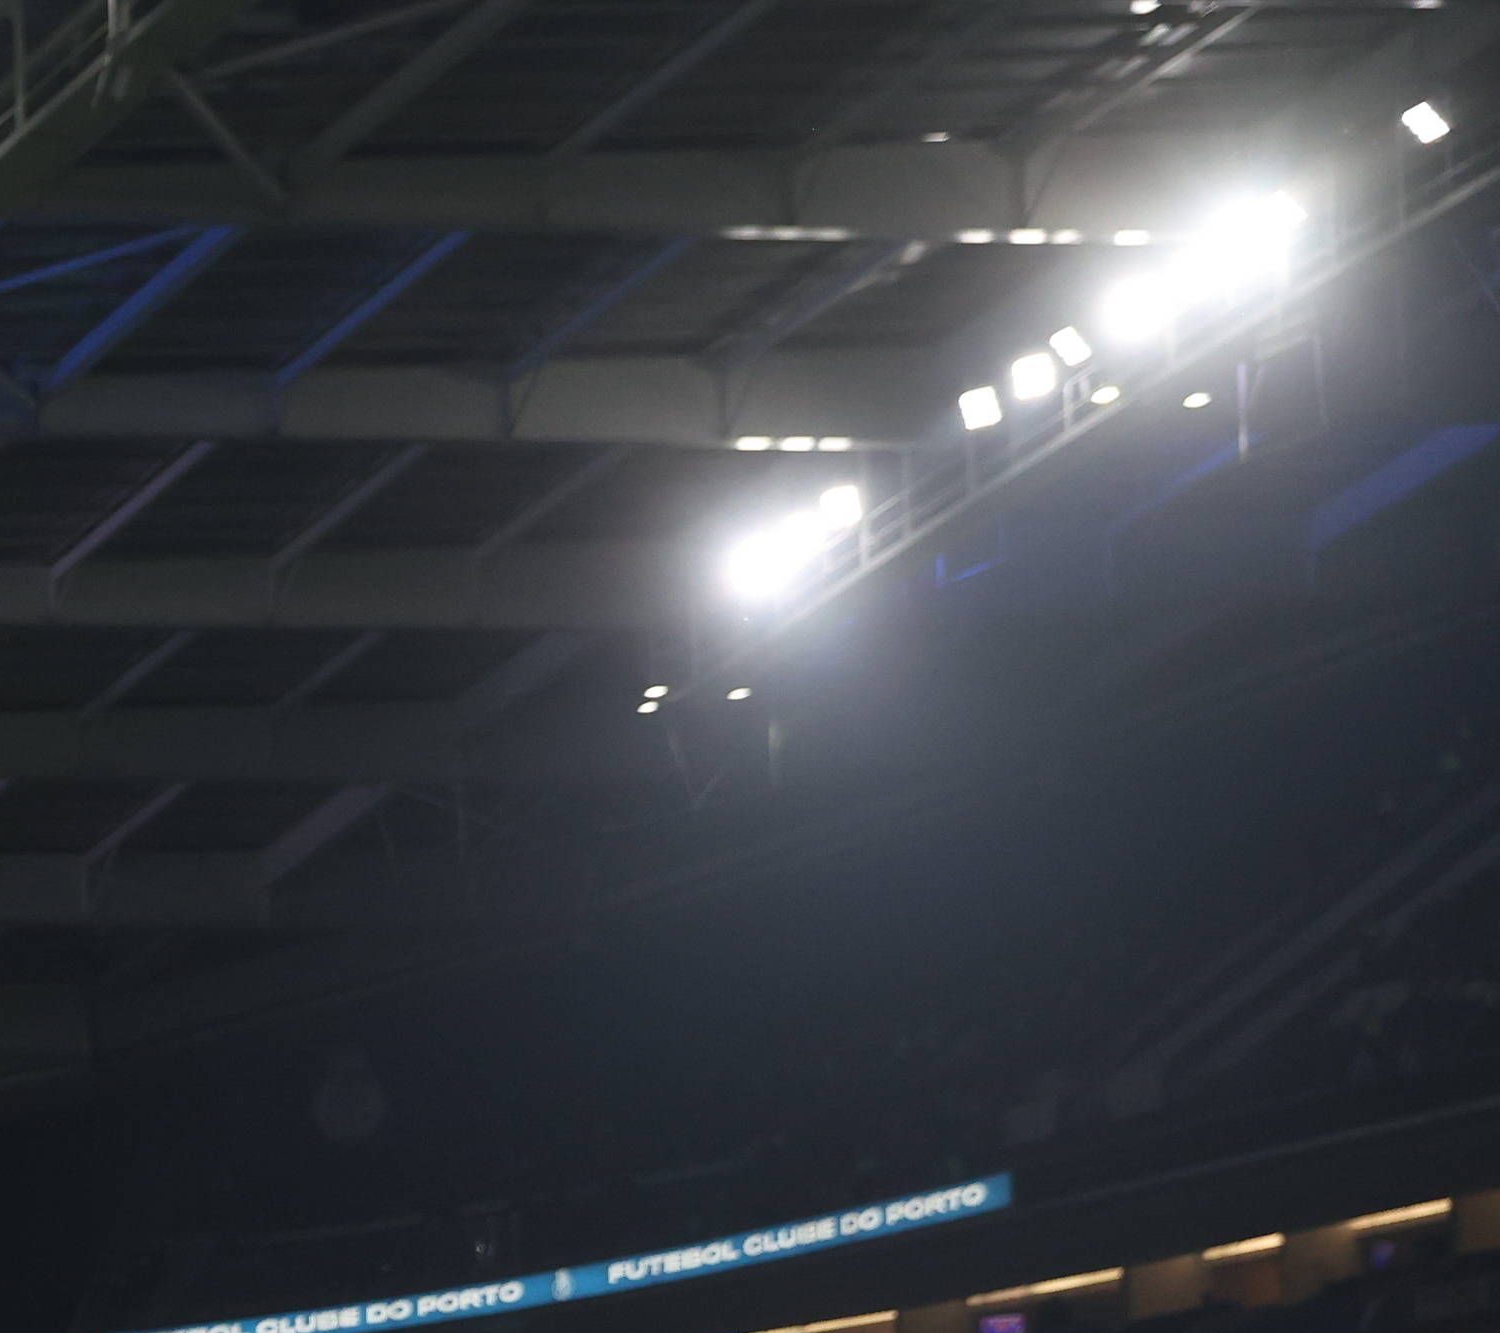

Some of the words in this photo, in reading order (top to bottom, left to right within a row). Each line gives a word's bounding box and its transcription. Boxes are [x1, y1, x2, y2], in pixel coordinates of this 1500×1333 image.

[608, 1240, 742, 1284] FUTEBOL
[741, 1216, 837, 1258] CLUBE
[839, 1210, 885, 1236] DO
[885, 1181, 988, 1226] PORTO
[365, 1299, 412, 1324] DO
[417, 1280, 526, 1317] PORTO
